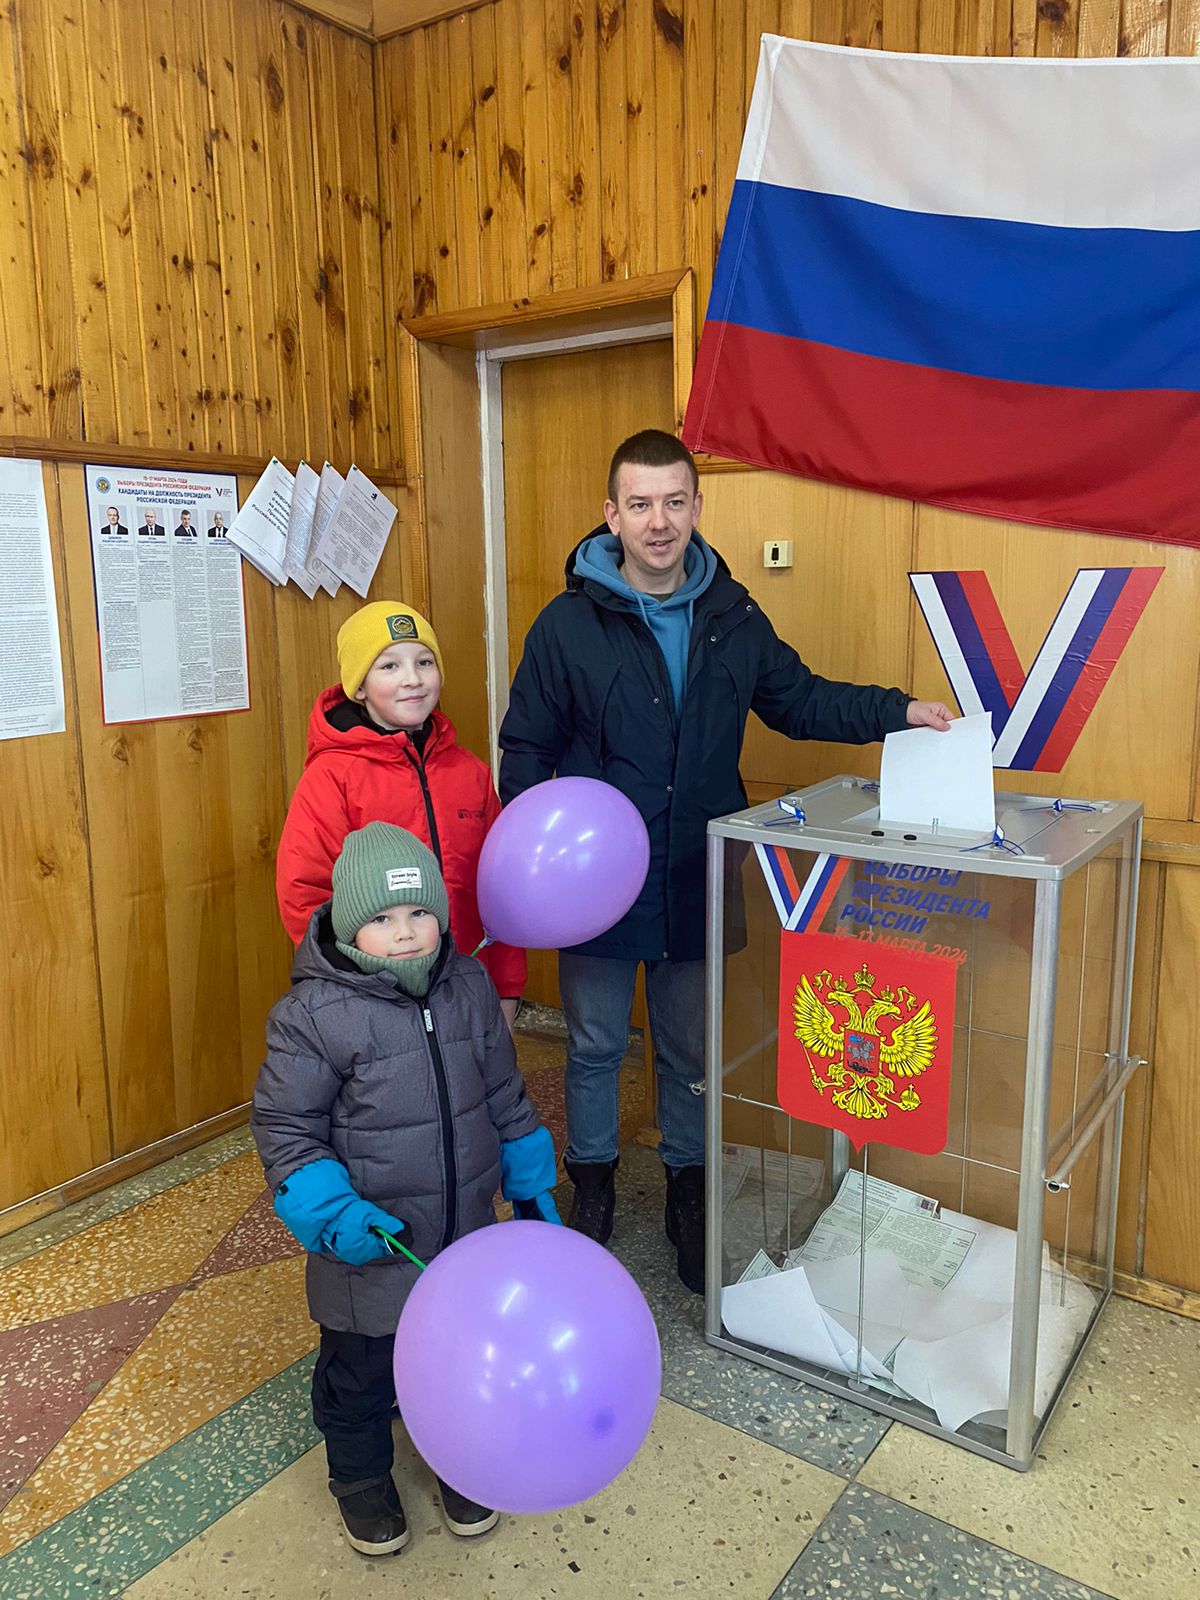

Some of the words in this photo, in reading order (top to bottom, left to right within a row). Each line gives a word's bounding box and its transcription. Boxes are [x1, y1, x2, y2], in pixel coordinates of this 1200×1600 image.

[118, 488, 148, 496] КАНДИДАТЫ
[155, 490, 183, 498] ДОЛЖНОСТЬ
[136, 496, 168, 504] РОССИЙСКОЙ
[169, 498, 196, 506] ФЕДЕРАЦИИ
[863, 861, 964, 888] ВЫБОРЫ
[851, 878, 992, 921] ПРЕЗИДЕНТА
[839, 903, 929, 935] РОССИИ
[930, 943, 969, 966] 2024
